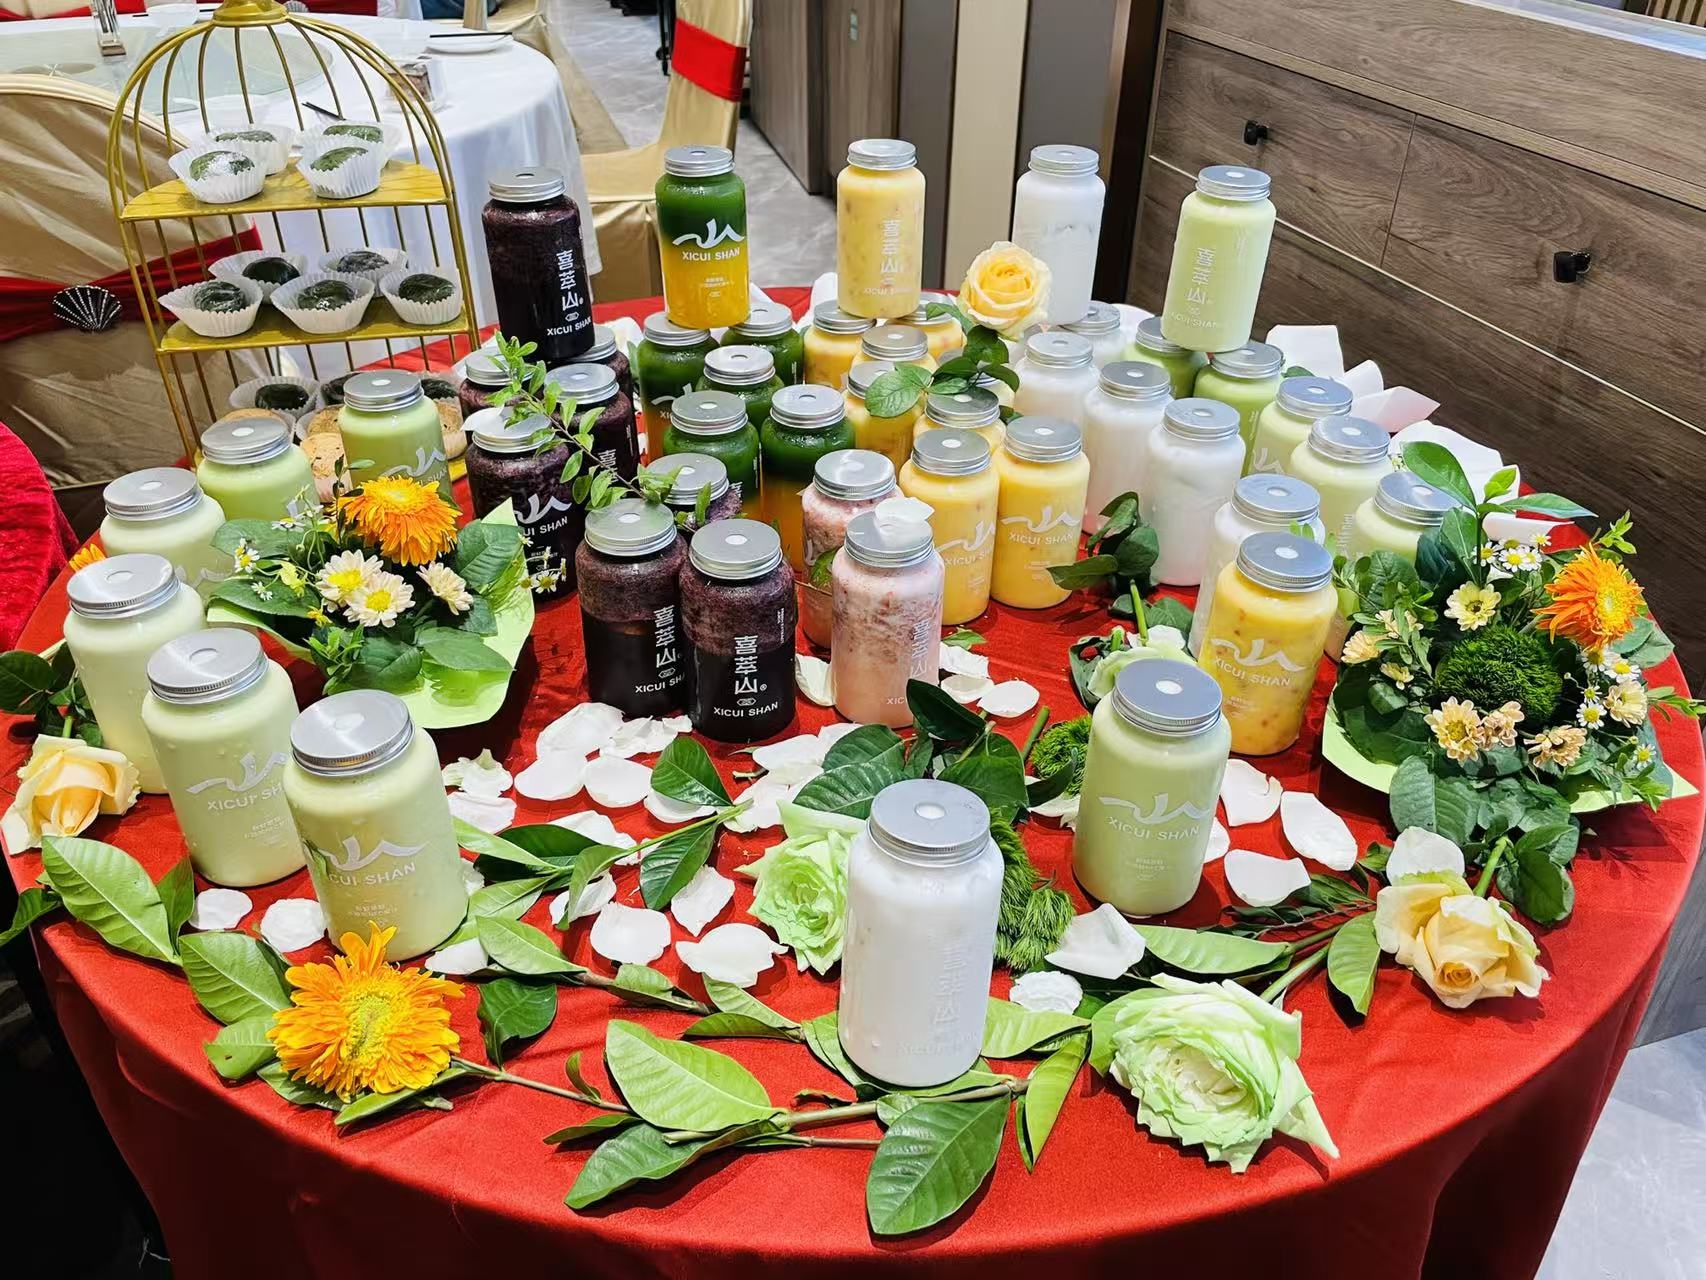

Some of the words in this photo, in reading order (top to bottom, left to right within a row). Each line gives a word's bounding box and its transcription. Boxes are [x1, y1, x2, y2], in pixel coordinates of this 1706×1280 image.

[682, 251, 711, 261] XICUI
[715, 247, 740, 260] SHAN
[547, 324, 573, 336] XICUI
[540, 516, 568, 534] SHAN
[1008, 532, 1041, 545] XICUI
[1045, 532, 1073, 545] SHAN
[734, 635, 758, 695] 喜萃山
[1214, 656, 1246, 679] XICUI
[1249, 673, 1290, 686] SHAN
[635, 682, 666, 693] XICUI
[669, 672, 685, 686] SH
[713, 707, 744, 717] XICUI
[748, 701, 778, 716] SHAN
[208, 794, 255, 810] XICUI
[261, 782, 282, 800] SH
[1108, 816, 1151, 839] XICUI
[1157, 826, 1200, 840] SHAN
[329, 873, 357, 886] CUI
[365, 861, 416, 885] SHAN
